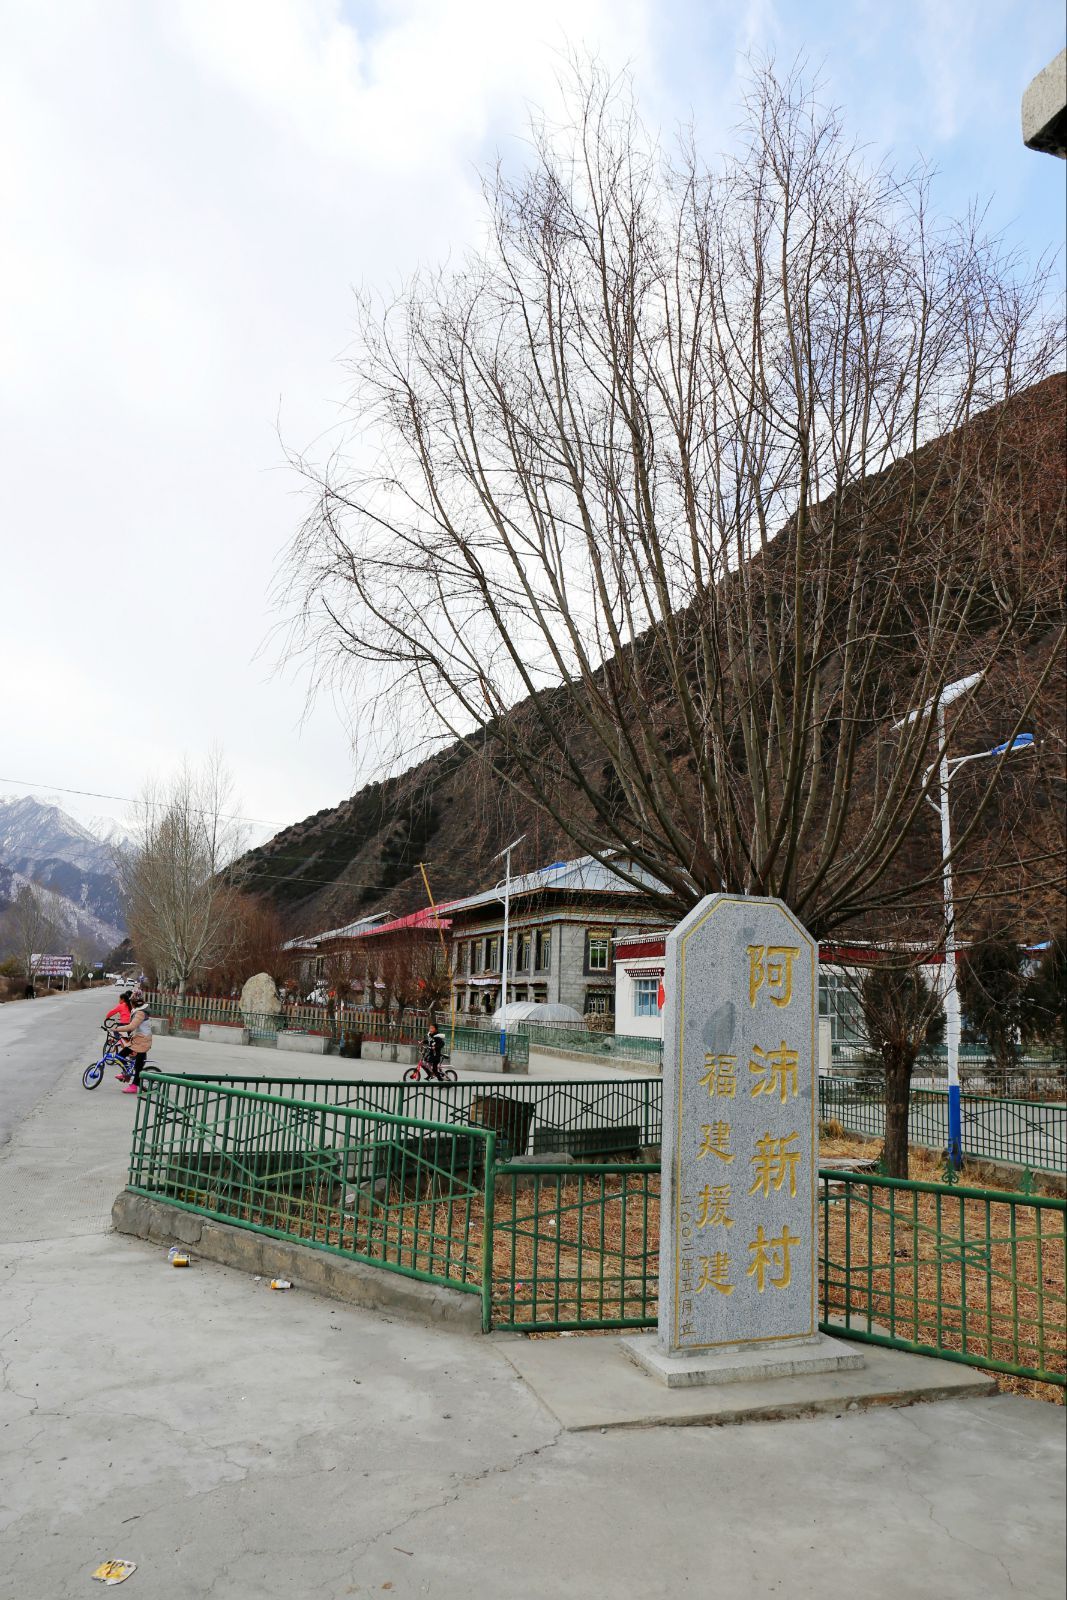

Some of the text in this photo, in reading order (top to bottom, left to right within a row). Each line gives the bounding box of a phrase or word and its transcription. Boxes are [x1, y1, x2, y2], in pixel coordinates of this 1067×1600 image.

[696, 1053, 736, 1296] 福建援建
[746, 944, 801, 1293] 阿沛新村
